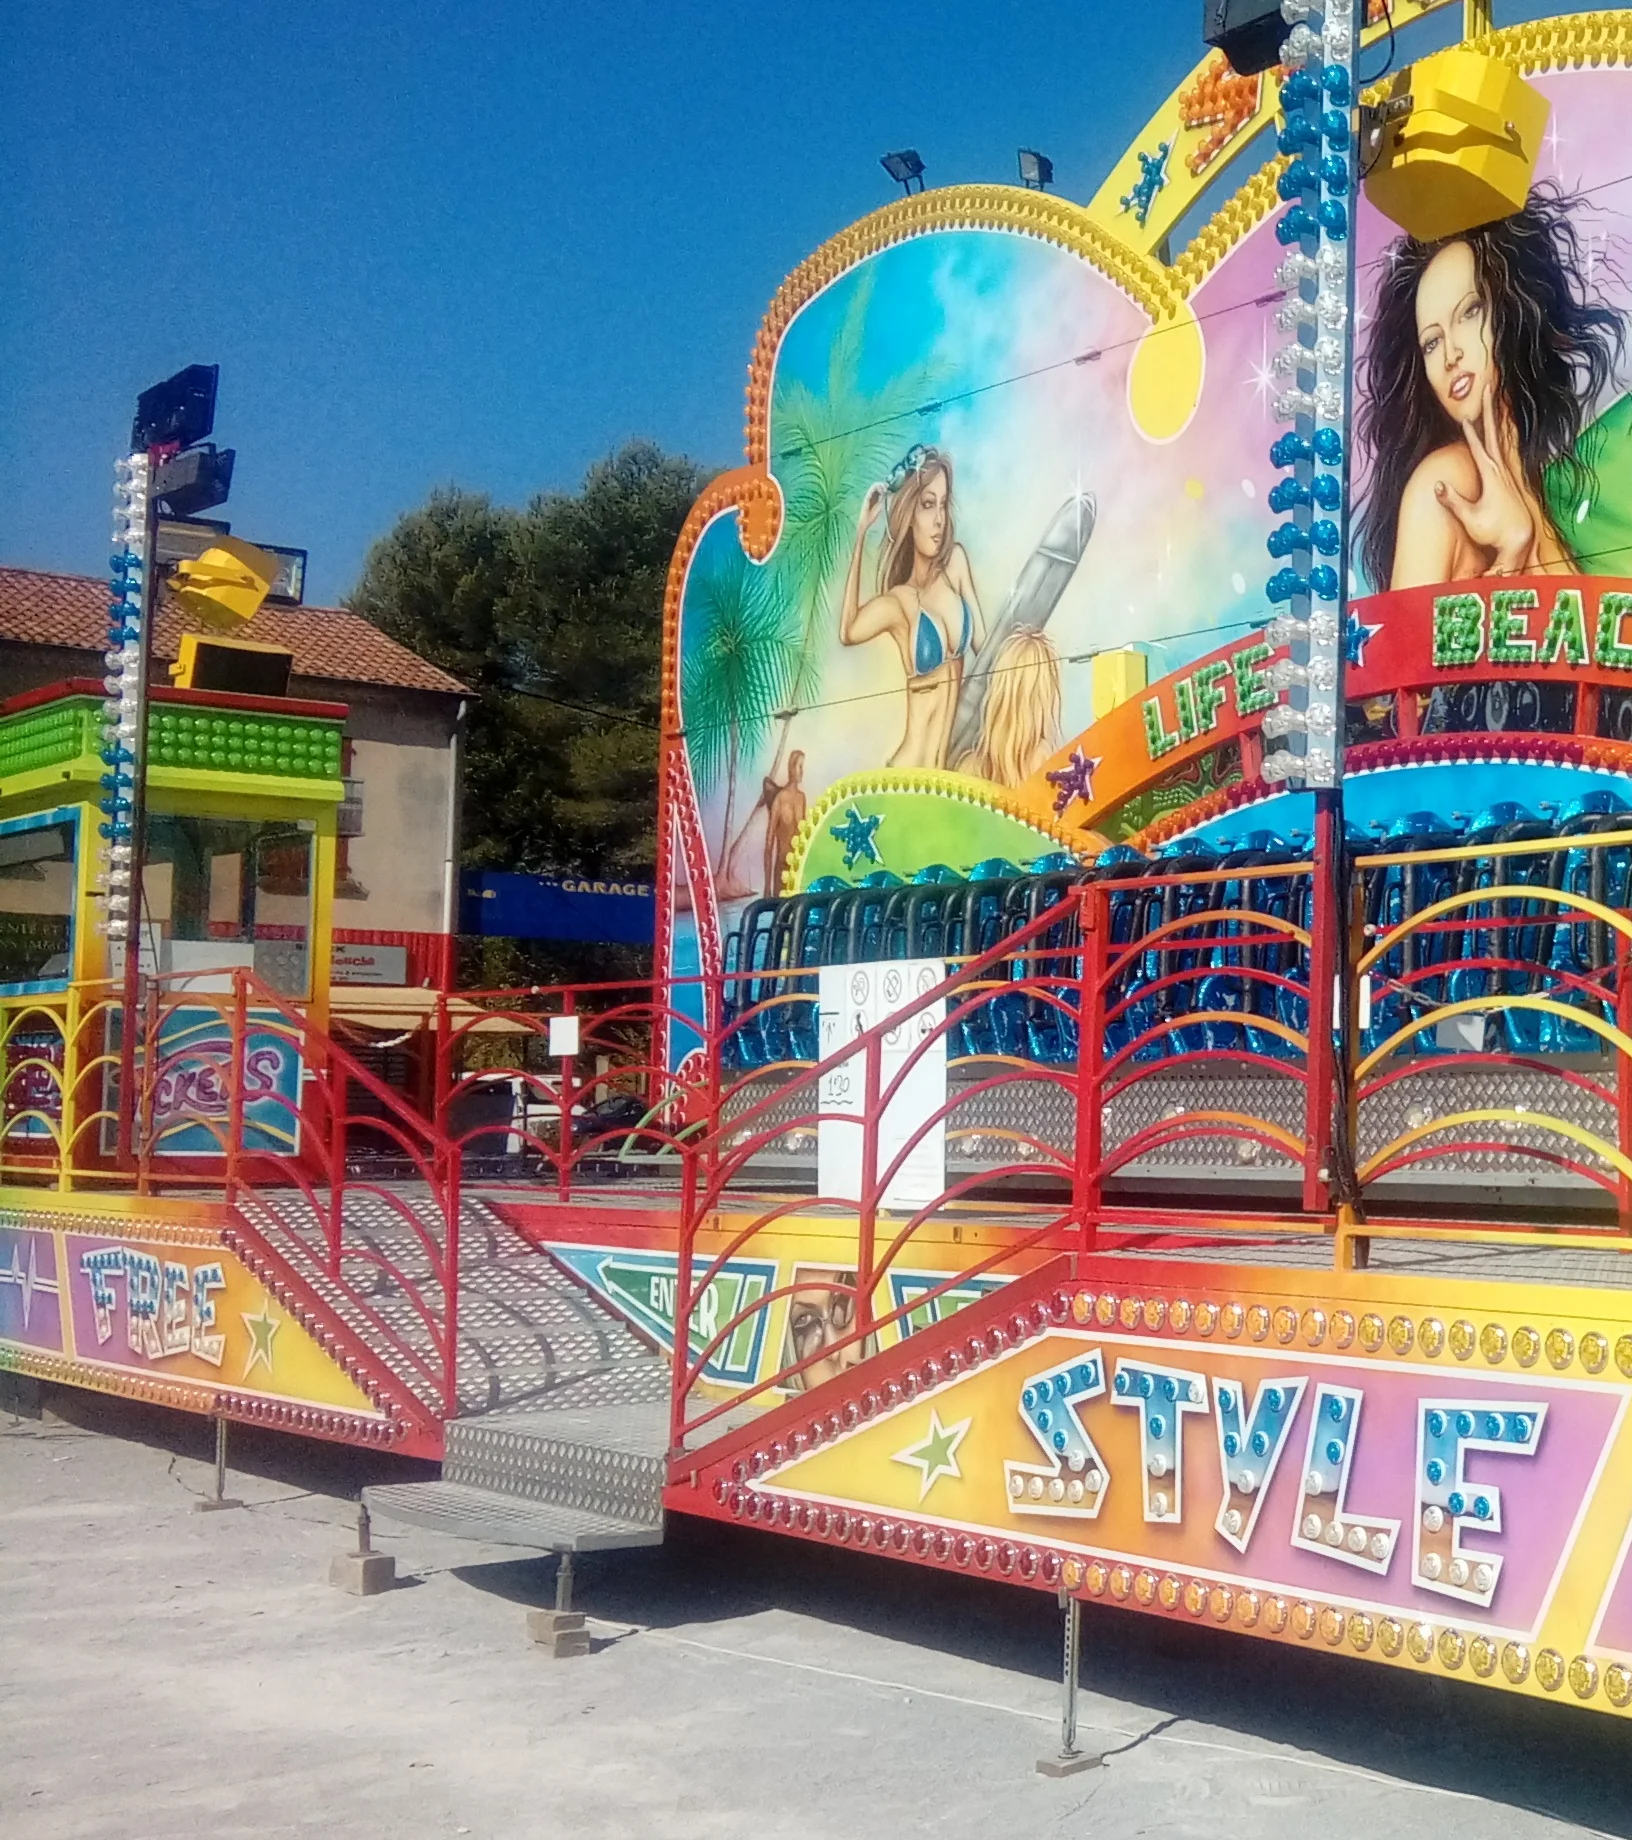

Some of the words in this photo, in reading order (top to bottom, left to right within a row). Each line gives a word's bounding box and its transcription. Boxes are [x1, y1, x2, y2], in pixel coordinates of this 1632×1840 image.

[1142, 641, 1279, 761] LIFE
[561, 879, 650, 897] GARAGE
[79, 1245, 226, 1367] FREE
[651, 1275, 719, 1345] ENER
[1002, 1347, 1549, 1609] STYLE
